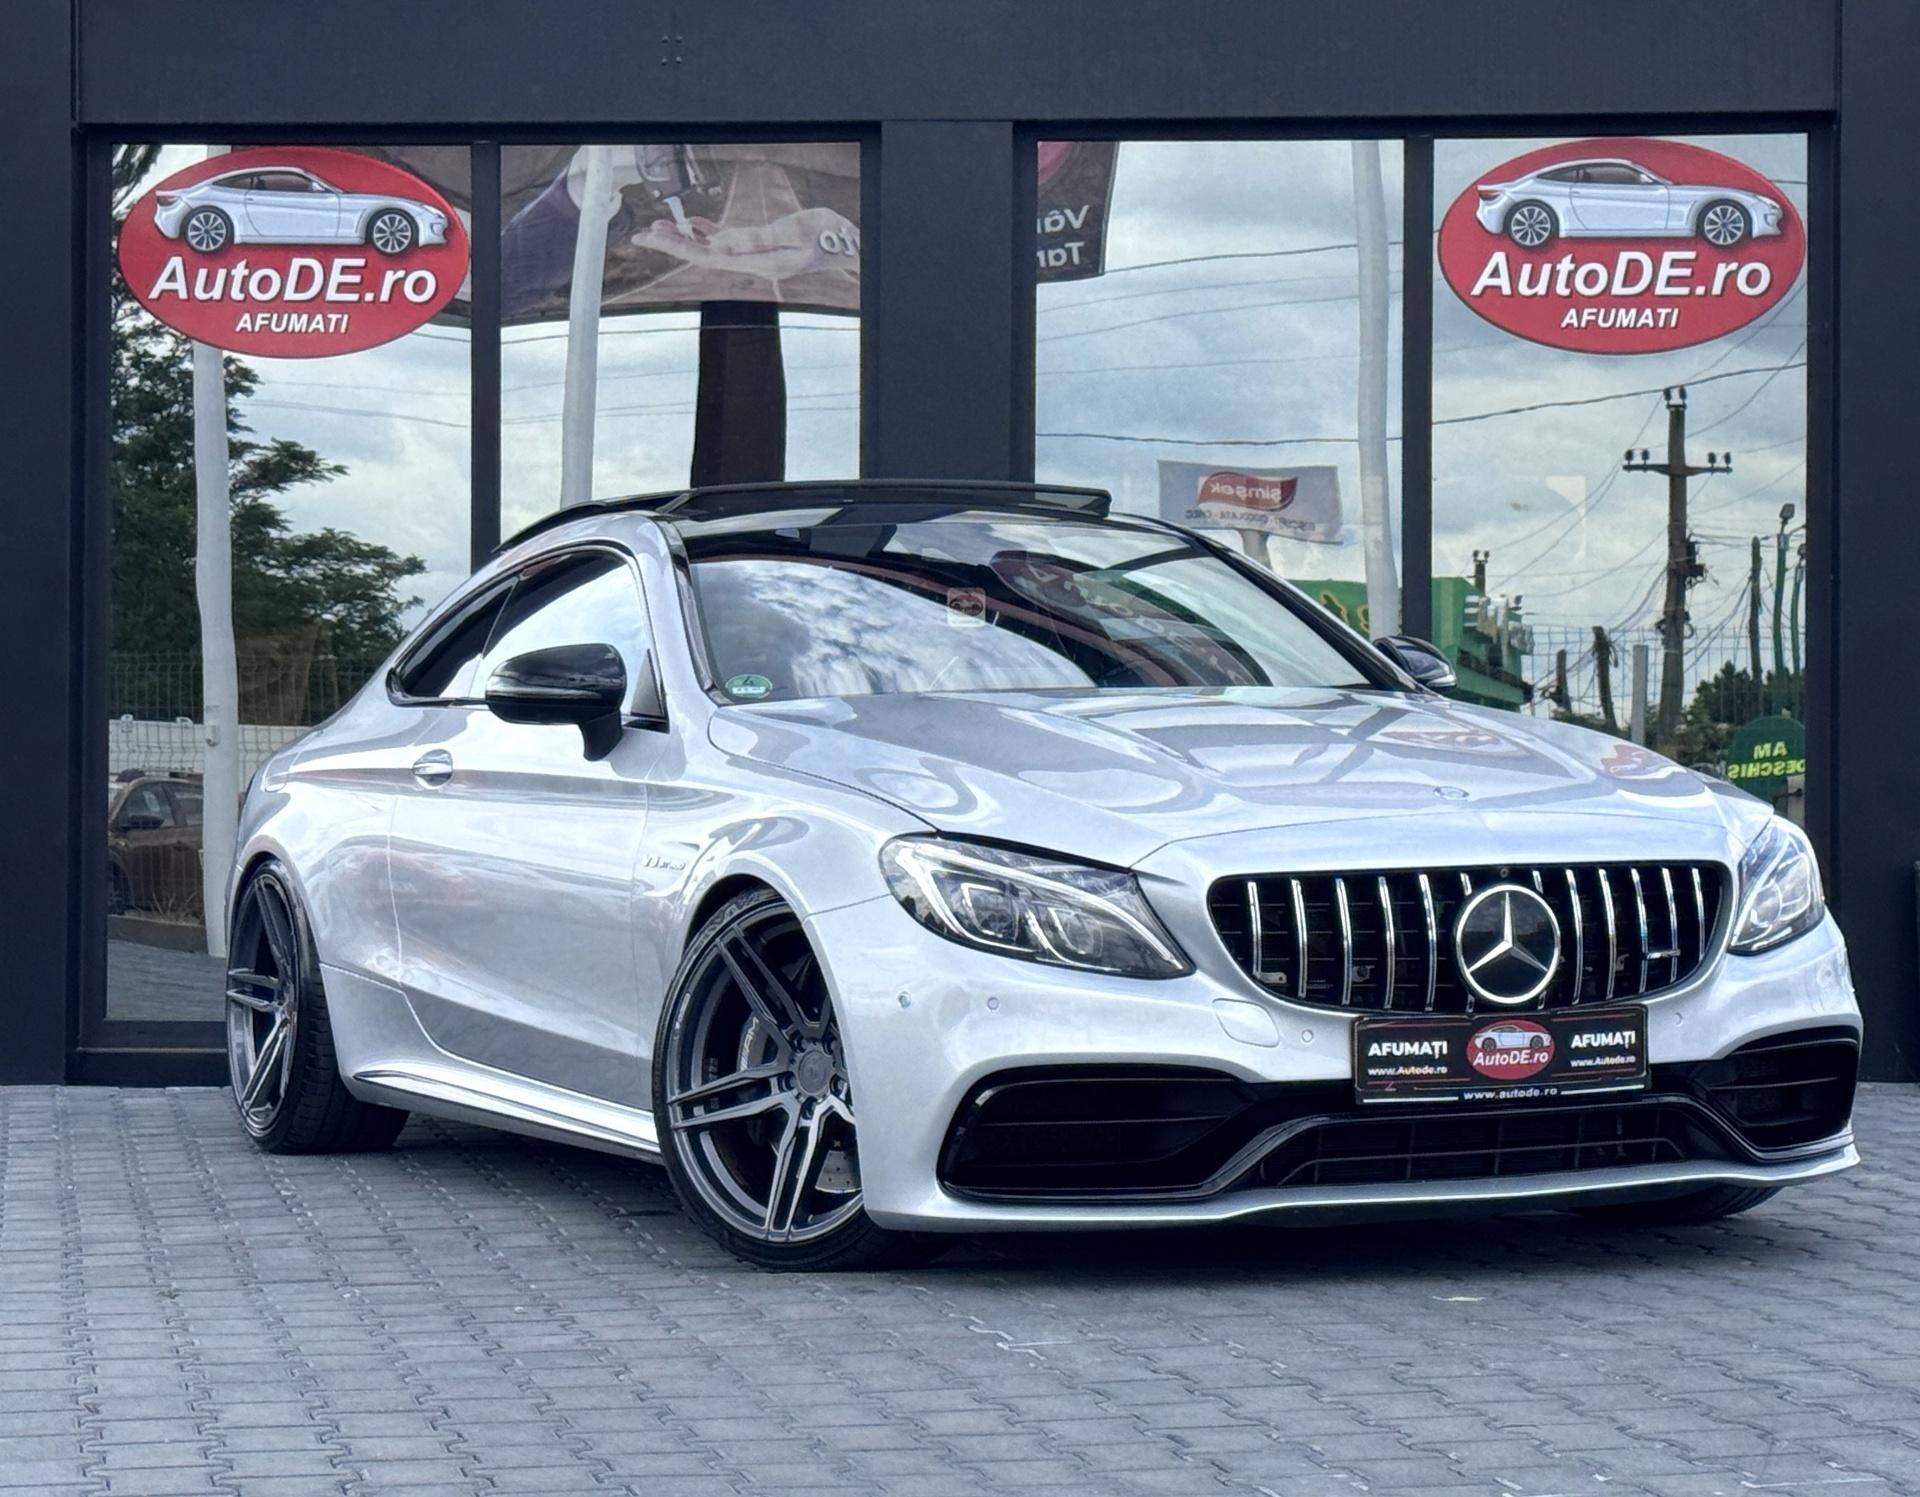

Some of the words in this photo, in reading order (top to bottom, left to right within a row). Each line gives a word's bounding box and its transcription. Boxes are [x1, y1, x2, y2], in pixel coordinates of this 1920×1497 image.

[148, 255, 437, 302] AutoDE.ro
[1470, 250, 1772, 297] AutoDE.ro
[235, 312, 350, 334] AFUMATI
[1561, 307, 1679, 329] AFUMATI
[1472, 1049, 1549, 1067] AutoDE.ro
[1368, 1065, 1448, 1076] www.Autode.ro
[1463, 1088, 1558, 1100] www.autode.ro
